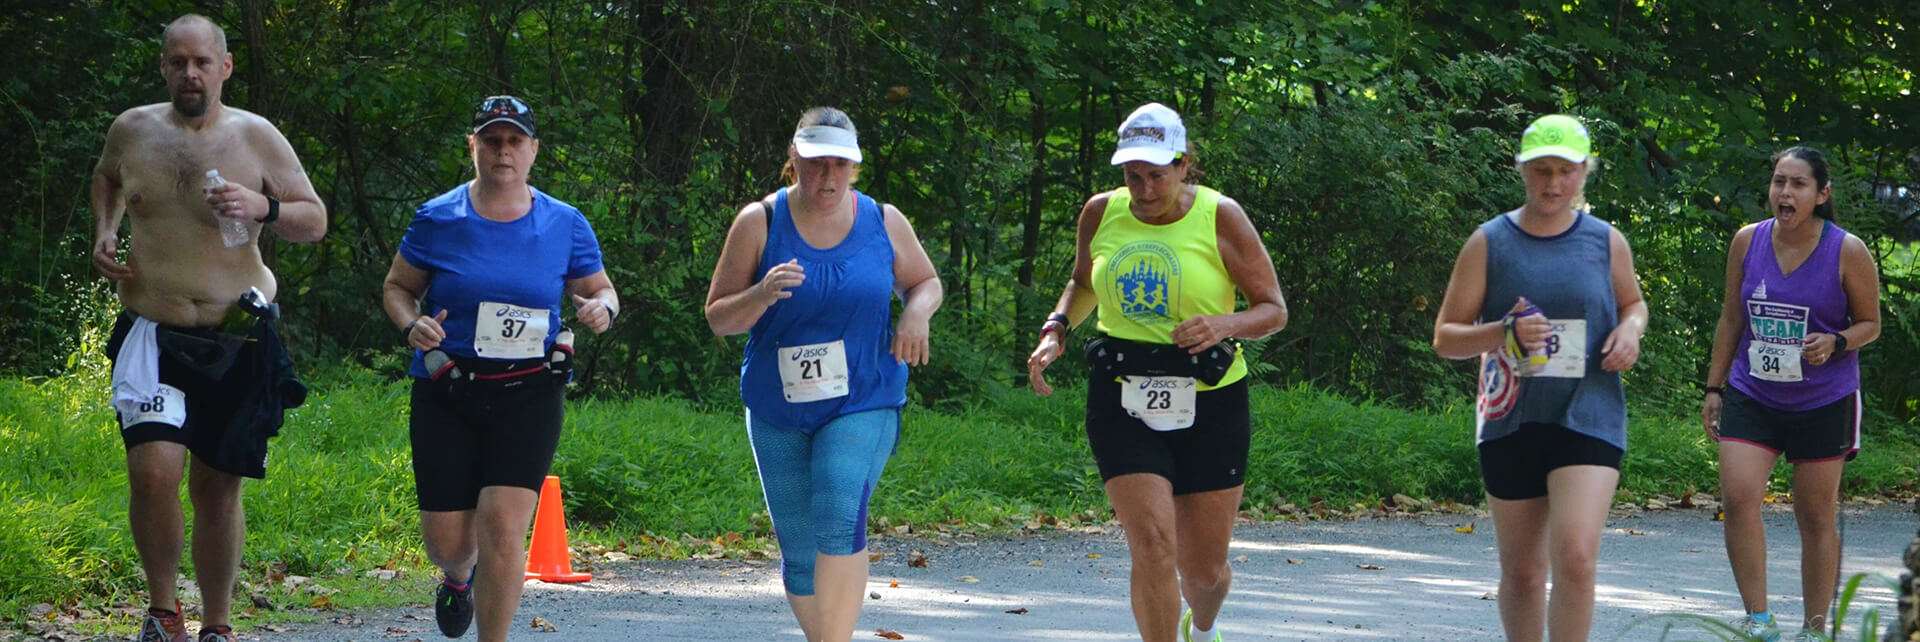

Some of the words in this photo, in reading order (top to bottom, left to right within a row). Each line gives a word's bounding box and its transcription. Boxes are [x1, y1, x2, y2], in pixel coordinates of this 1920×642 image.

[502, 318, 527, 338] 37
[1751, 317, 1806, 340] TEAM
[800, 358, 822, 380] 21
[1762, 355, 1780, 374] 34
[1146, 389, 1171, 410] 23
